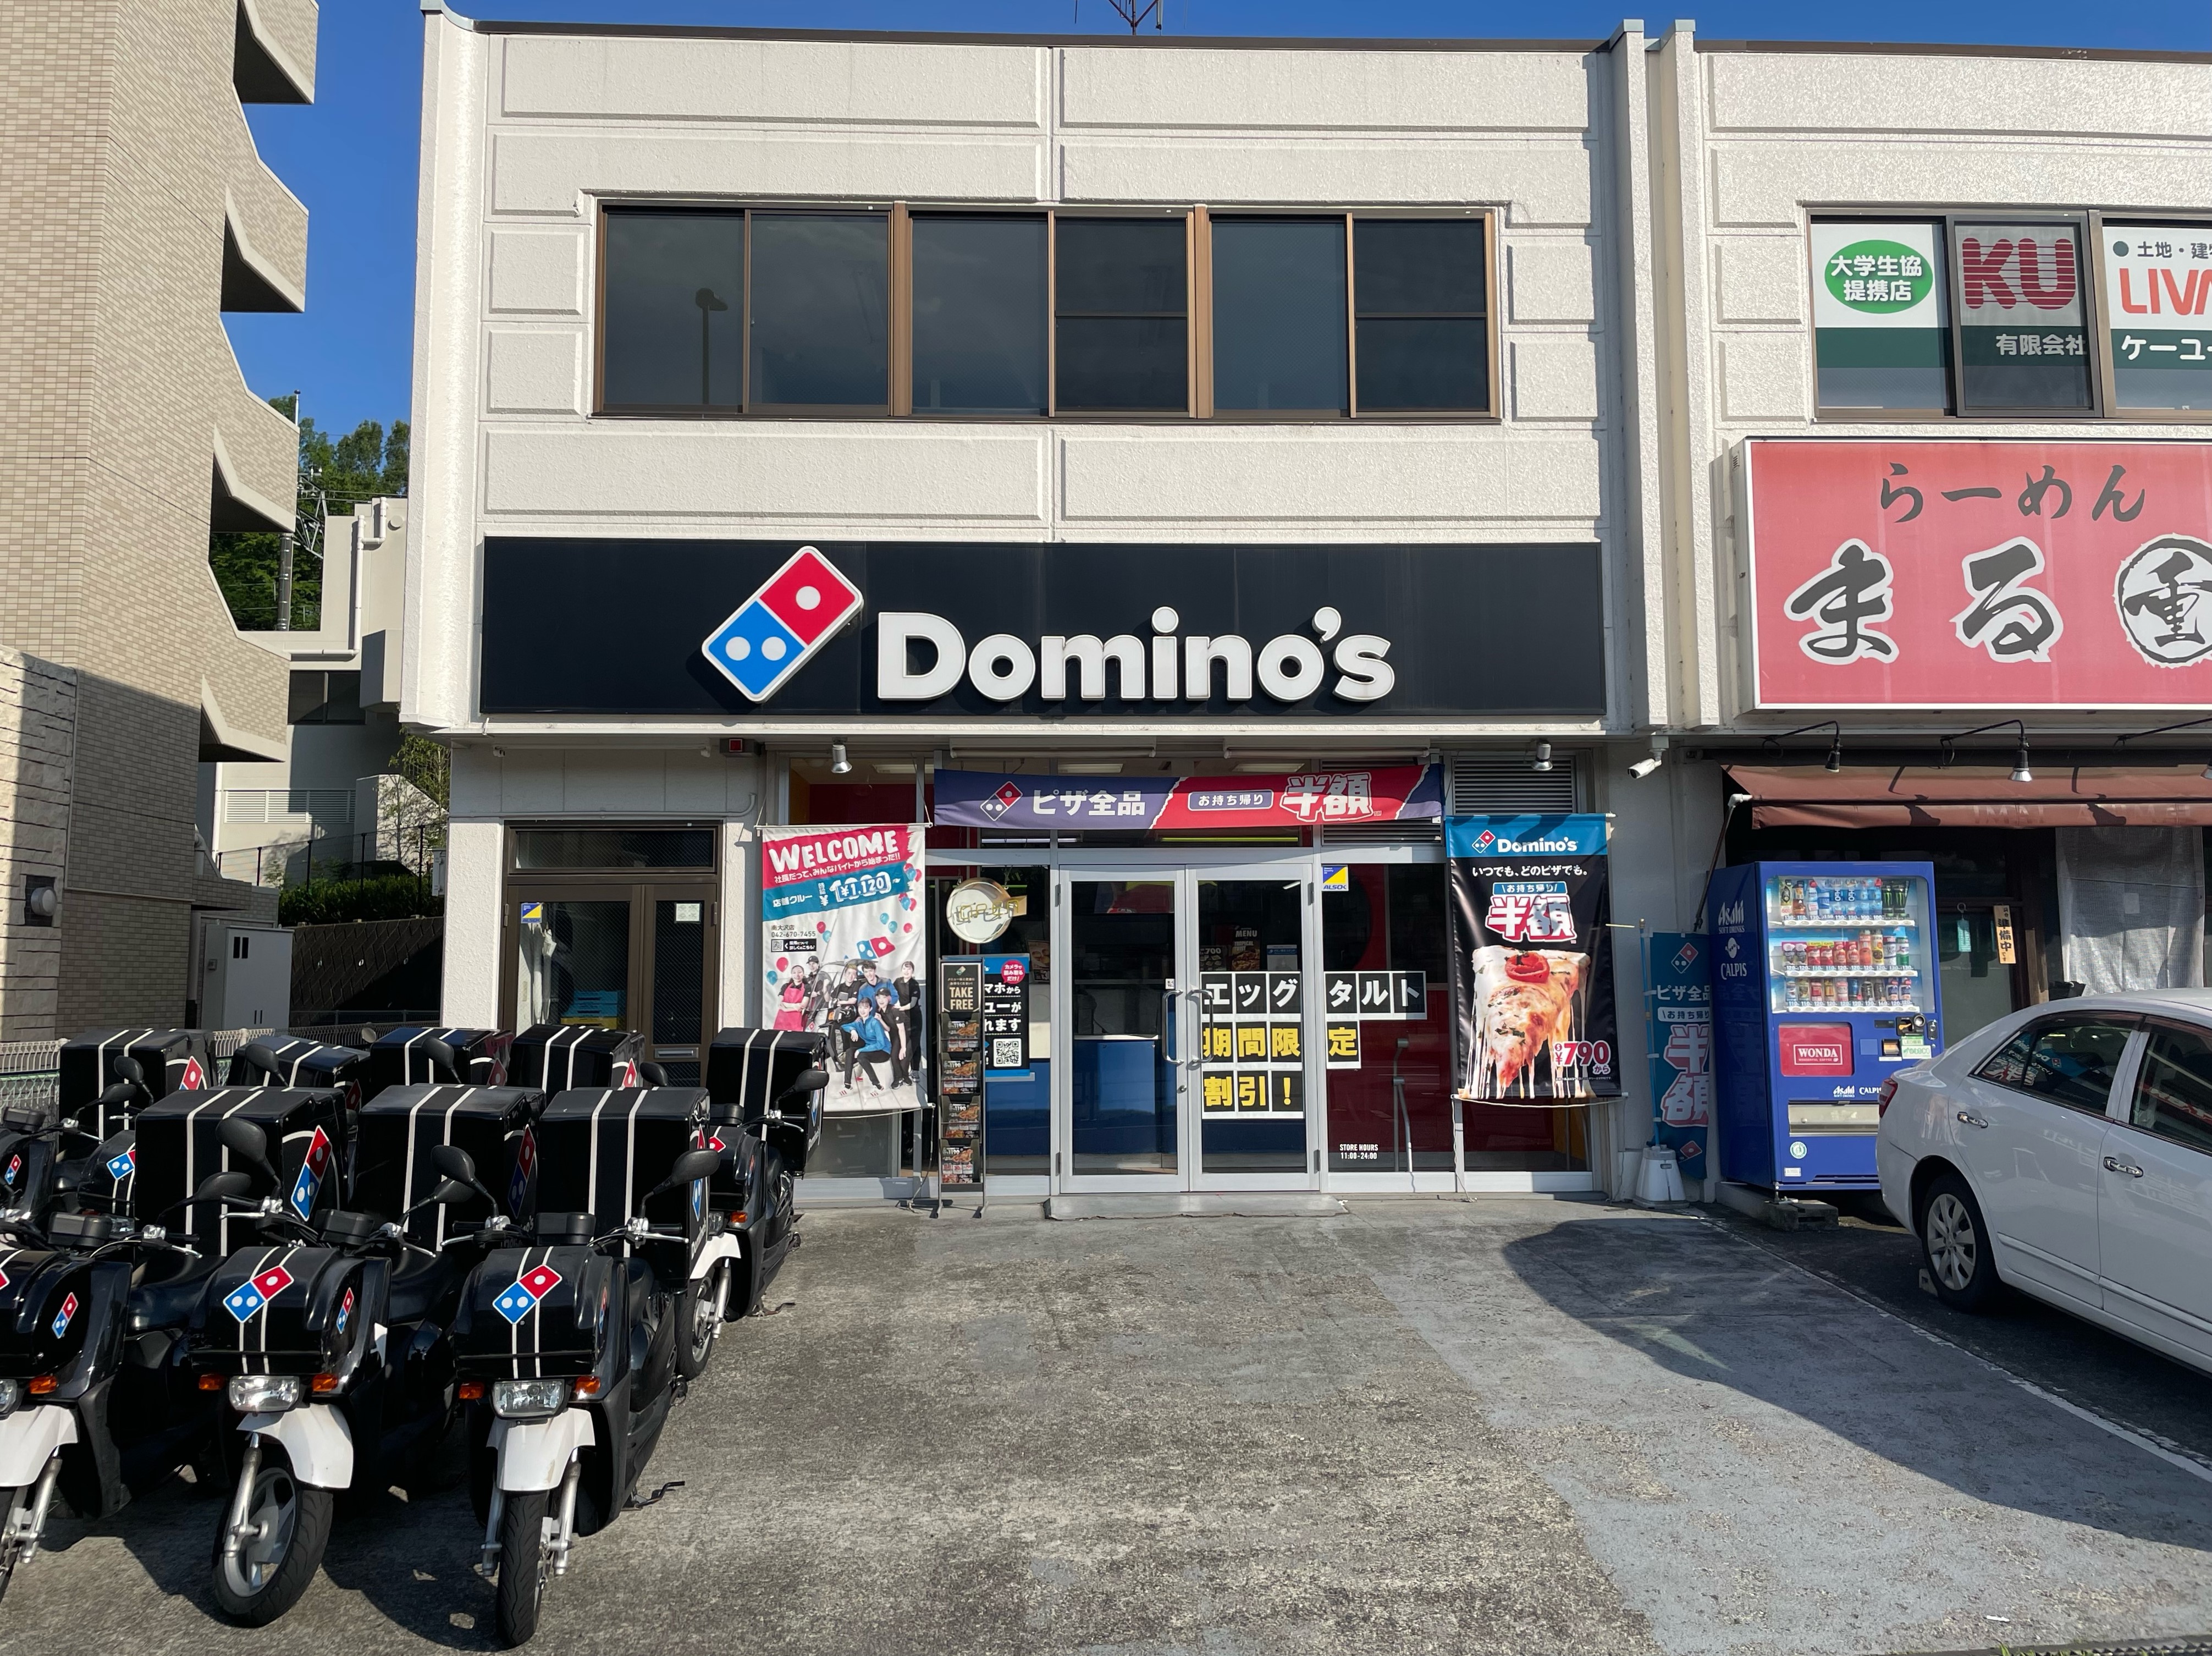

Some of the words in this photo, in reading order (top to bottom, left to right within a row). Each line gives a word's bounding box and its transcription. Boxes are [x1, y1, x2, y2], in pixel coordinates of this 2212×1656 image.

[2137, 241, 2211, 259] 土地・建
[1830, 255, 1922, 278] 大学生協
[1962, 238, 2076, 310] KU
[1843, 280, 1912, 302] 提携店
[1996, 334, 2087, 356] 有限会社
[2121, 334, 2211, 361] ケーユ
[1880, 462, 2145, 523] らーめん
[878, 606, 1395, 703] Domino's
[1033, 789, 1147, 817] ピザ全品
[1198, 793, 1265, 807] お持ち帰り
[1283, 774, 1371, 819] 半額
[769, 830, 899, 873] WELCOME
[1497, 837, 1577, 852] Domino's
[1472, 865, 1588, 877] いつでも、どのピザでも。
[1507, 884, 1554, 893] お持ち帰り
[773, 894, 813, 908] 店舗クルー
[1486, 895, 1576, 939] 半額
[1718, 900, 1745, 926] Asahi
[1720, 962, 1747, 980] CALPIS
[949, 987, 973, 998] TAKE
[1328, 979, 1420, 1008] タルト
[950, 999, 974, 1010] FREE
[1668, 1010, 1709, 1020] お持ち帰り
[1798, 1048, 1838, 1057] WONDA
[1594, 1065, 1610, 1073] から
[1833, 1085, 1855, 1094] Asahi
